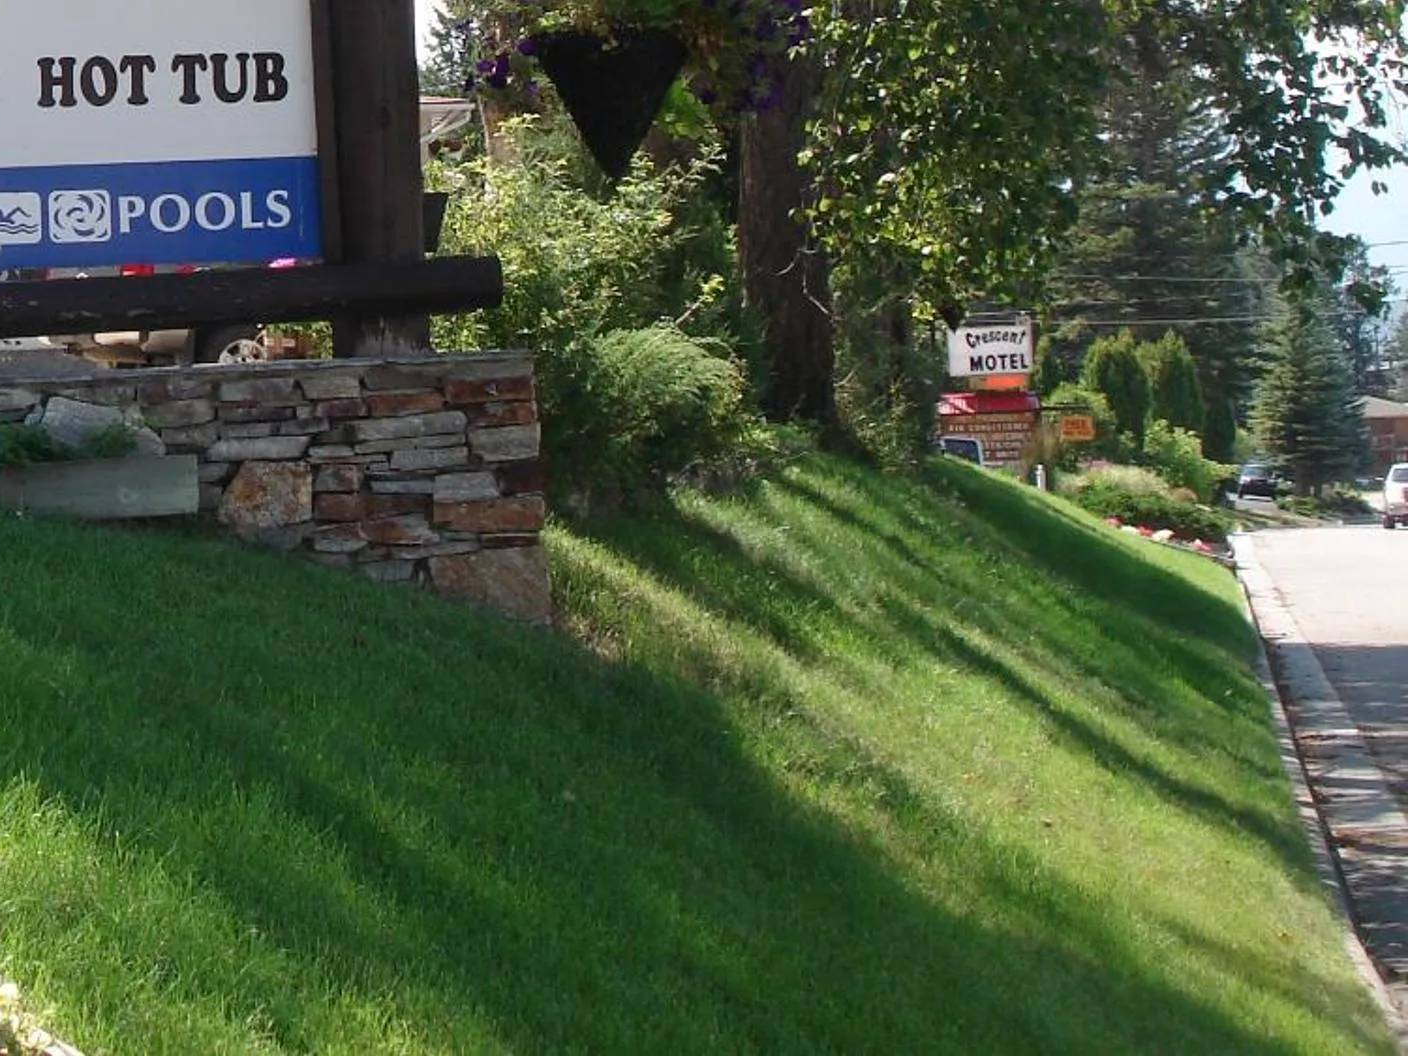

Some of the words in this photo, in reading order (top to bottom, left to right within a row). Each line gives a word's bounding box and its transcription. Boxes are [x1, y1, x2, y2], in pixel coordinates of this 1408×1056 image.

[36, 54, 157, 108] HOT
[170, 51, 289, 105] TUB
[118, 190, 292, 234] POOLS
[965, 329, 1027, 349] Crescent
[969, 353, 1029, 372] MOTEL
